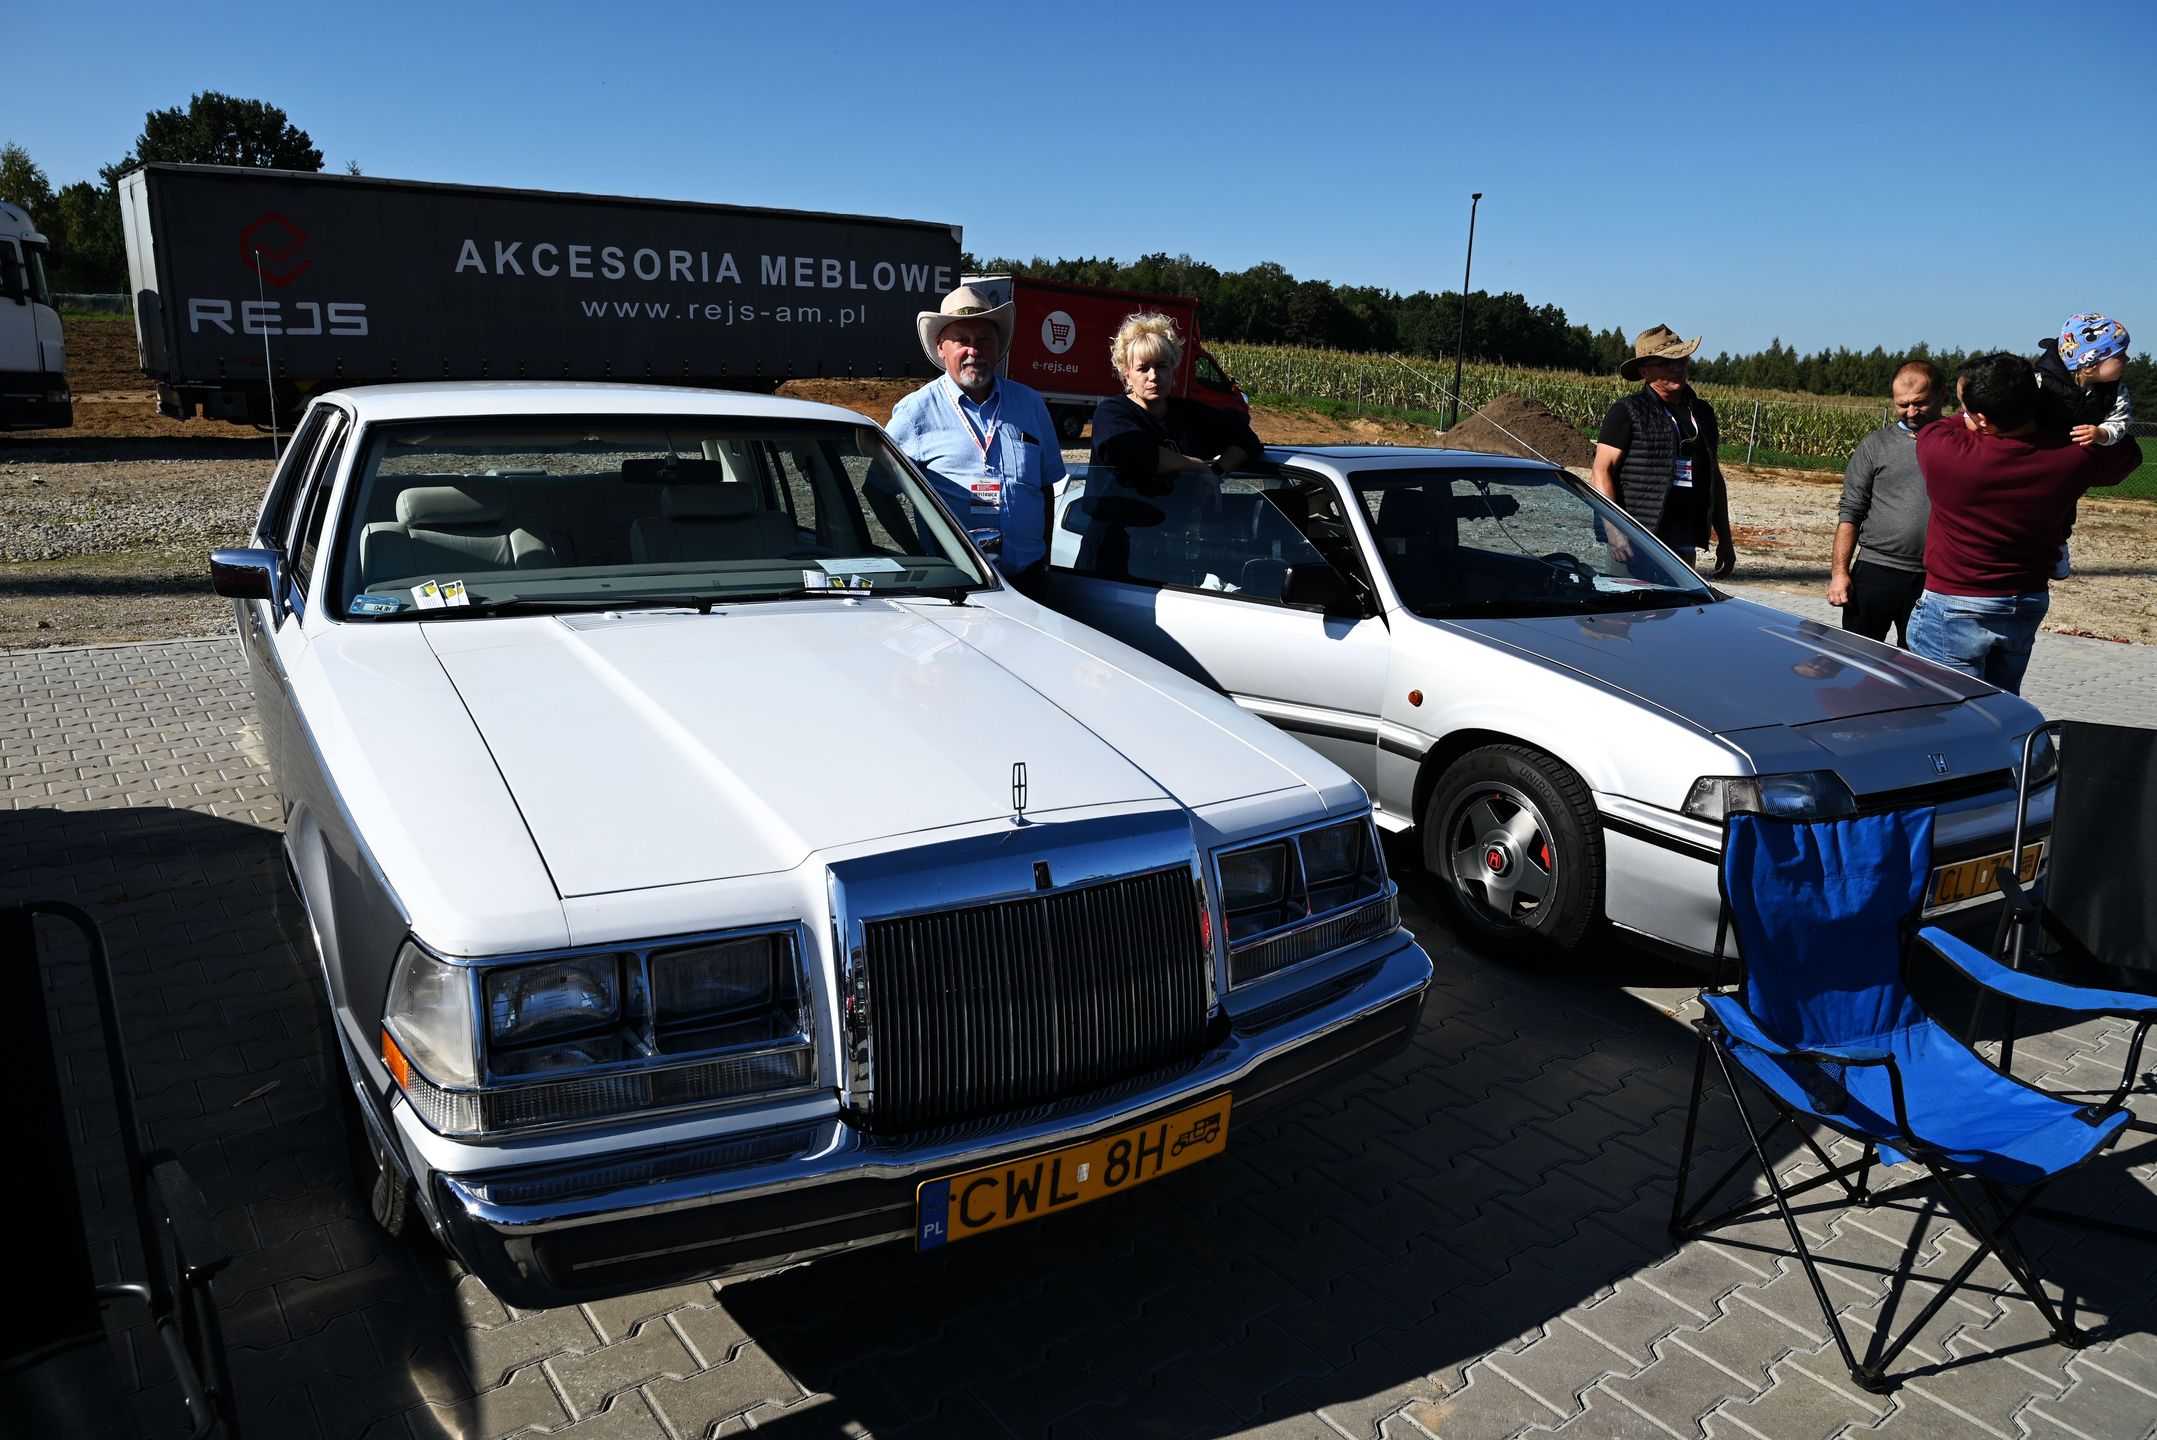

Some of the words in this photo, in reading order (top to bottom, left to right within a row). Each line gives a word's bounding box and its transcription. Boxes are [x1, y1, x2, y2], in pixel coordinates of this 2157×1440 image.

[455, 239, 743, 284] AKCESORIA
[760, 254, 952, 294] MEBLOWE
[189, 298, 369, 336] REJS
[581, 300, 866, 327] www.rejs-am.pl
[1032, 361, 1079, 374] e-rejs.eu
[1519, 767, 1566, 820] UNIROYAL
[959, 1158, 1079, 1228] CWL
[1103, 1124, 1168, 1187] 8H
[923, 1221, 944, 1239] PL
